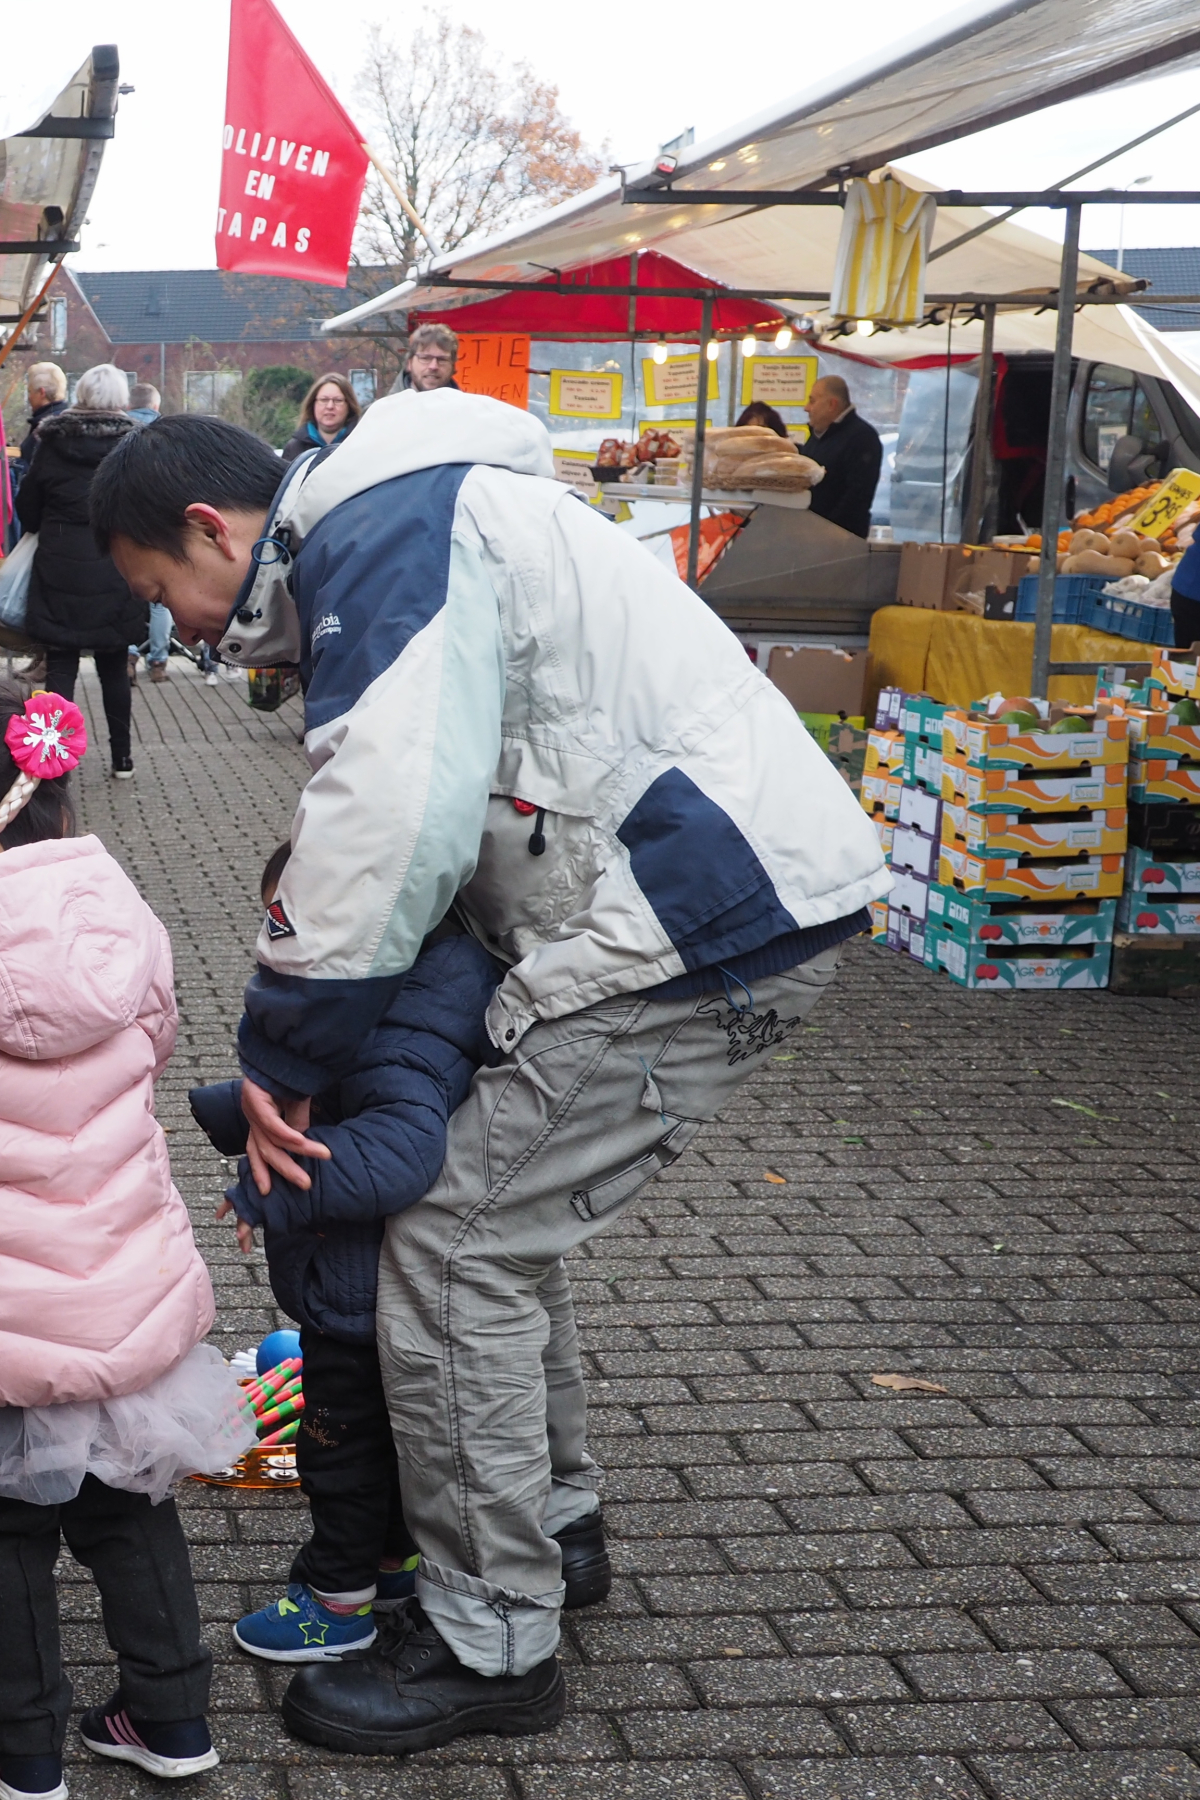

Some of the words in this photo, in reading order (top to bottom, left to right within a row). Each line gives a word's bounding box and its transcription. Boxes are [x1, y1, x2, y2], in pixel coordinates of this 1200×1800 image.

[223, 125, 330, 177] OLIJVEN
[244, 170, 275, 200] EN
[217, 208, 311, 253] TAPAS
